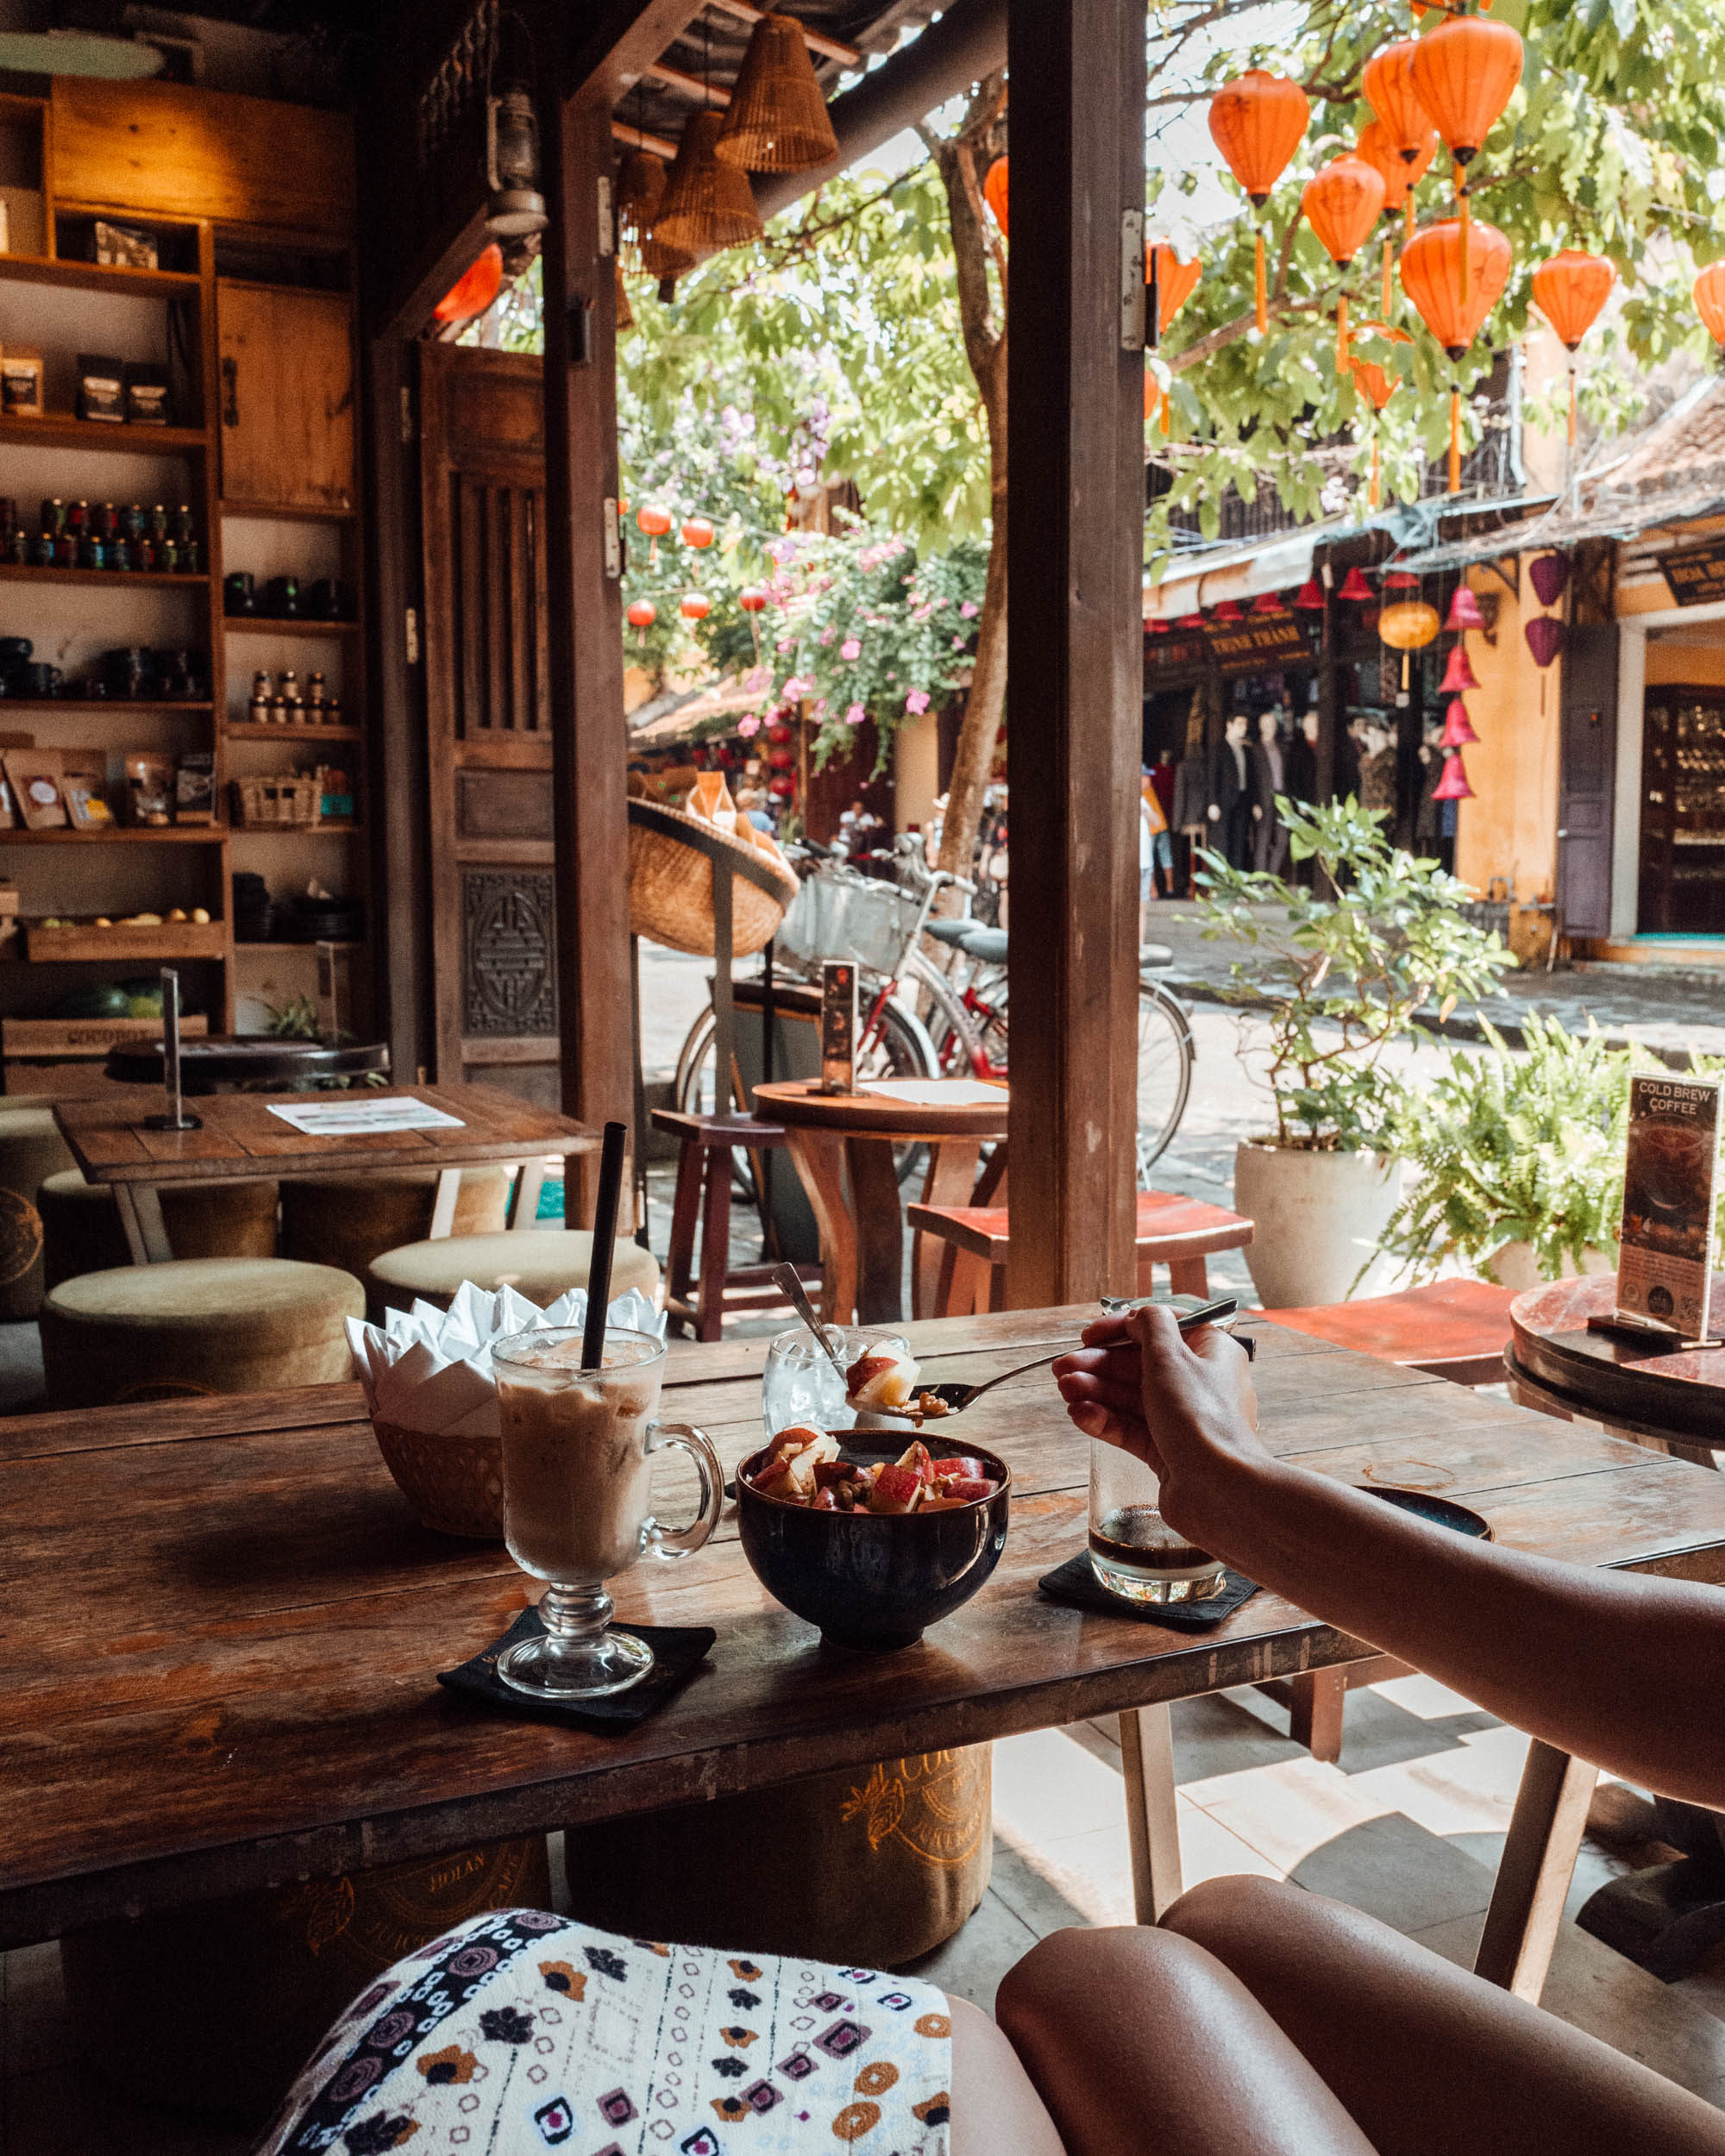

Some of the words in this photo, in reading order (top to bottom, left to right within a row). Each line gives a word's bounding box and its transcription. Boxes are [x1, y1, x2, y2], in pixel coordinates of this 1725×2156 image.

[1639, 1081, 1672, 1096] COLD
[1673, 1086, 1710, 1102] BREW
[1649, 1097, 1697, 1115] COFFEE
